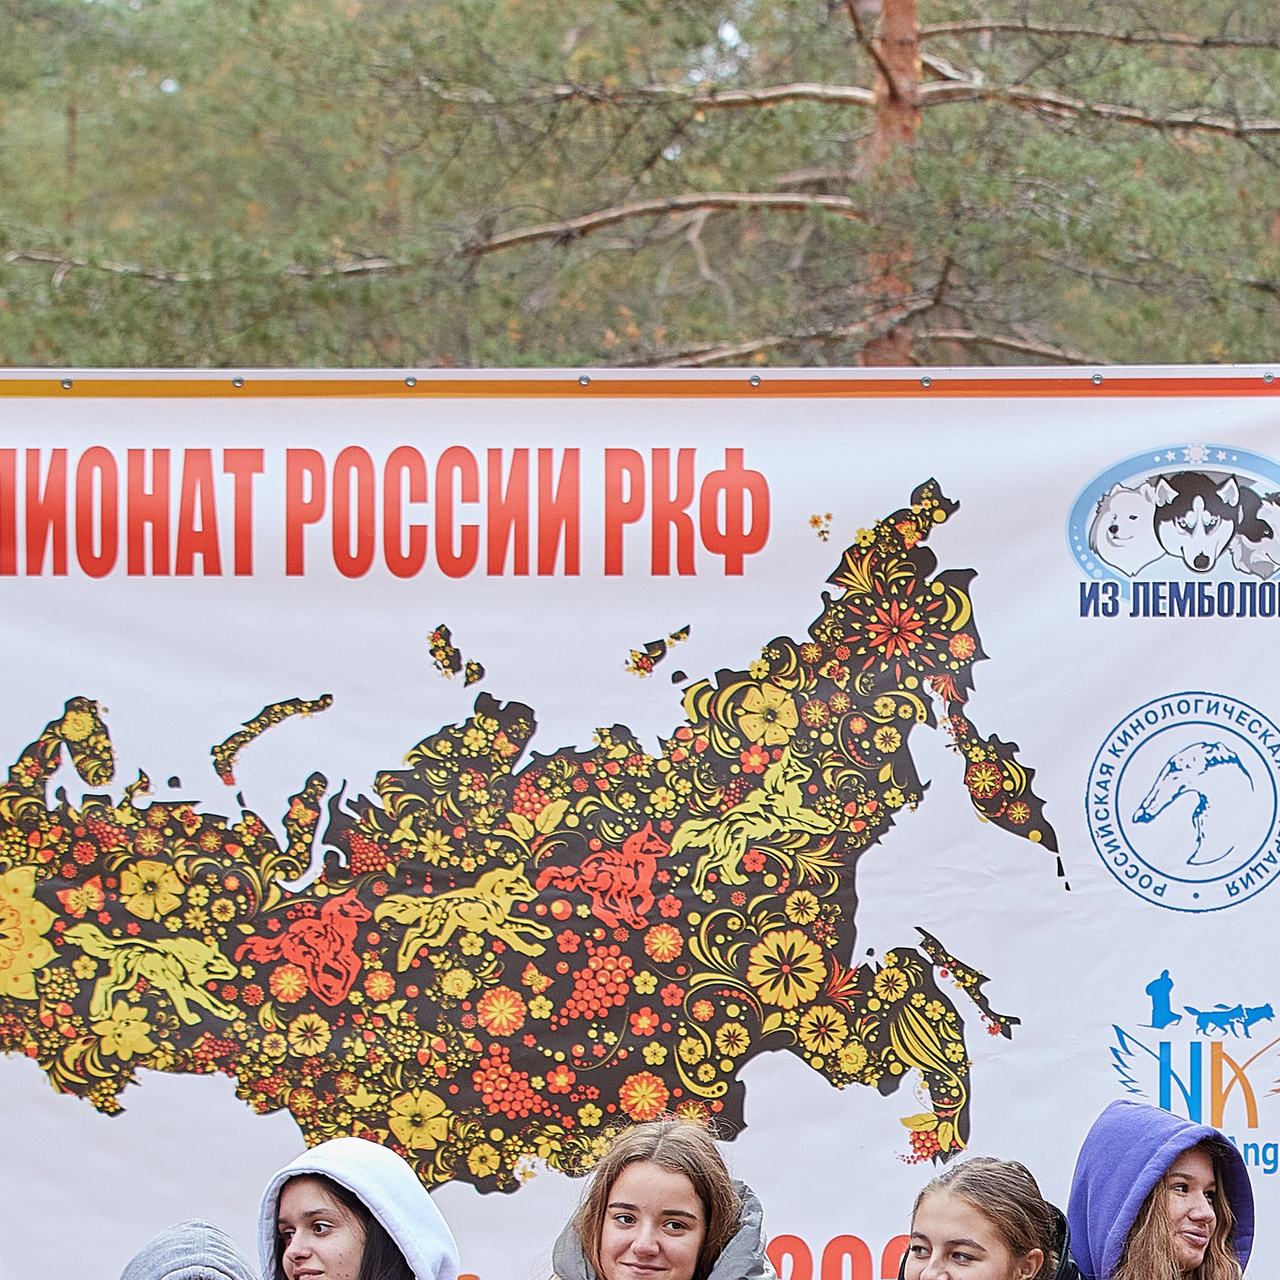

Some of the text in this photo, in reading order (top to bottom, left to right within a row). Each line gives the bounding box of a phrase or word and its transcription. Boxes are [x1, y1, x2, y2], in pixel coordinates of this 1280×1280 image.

[286, 446, 580, 579] РОССИИ
[604, 448, 770, 577] РКФ
[1079, 582, 1119, 617] ИЗ
[1094, 763, 1167, 897] РОССИЙСКАЯ
